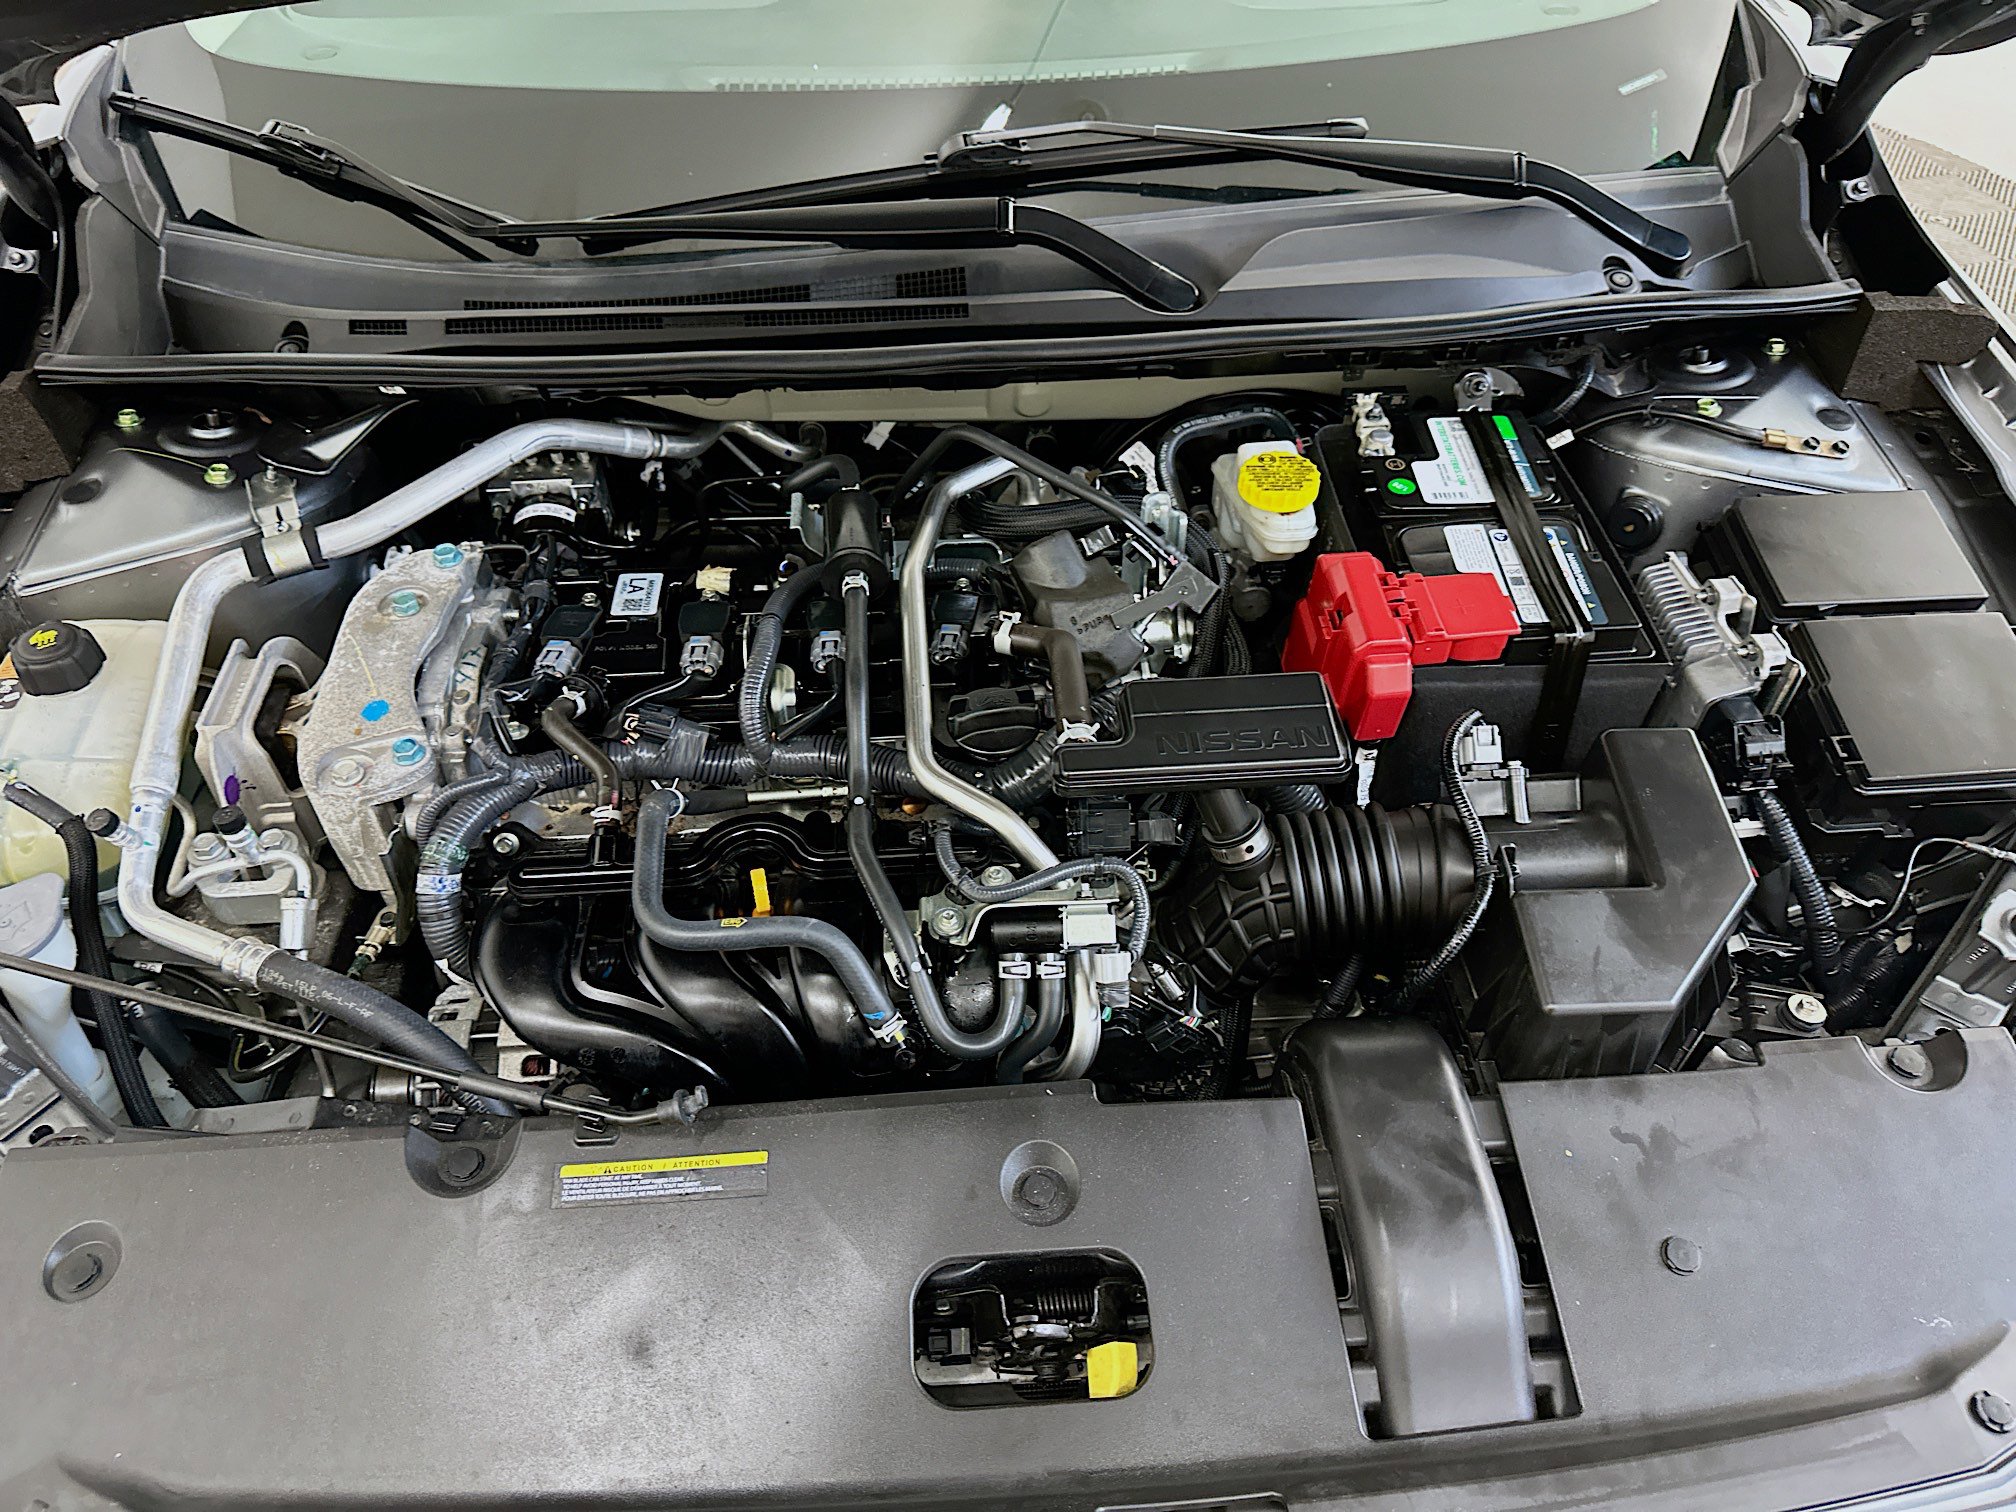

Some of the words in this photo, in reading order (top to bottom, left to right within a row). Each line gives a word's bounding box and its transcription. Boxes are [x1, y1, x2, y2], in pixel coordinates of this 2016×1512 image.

[627, 577, 647, 594] LA
[1157, 725, 1331, 756] NISSAN
[613, 1164, 653, 1173] CAUTION
[673, 1159, 721, 1169] ATTENTION
